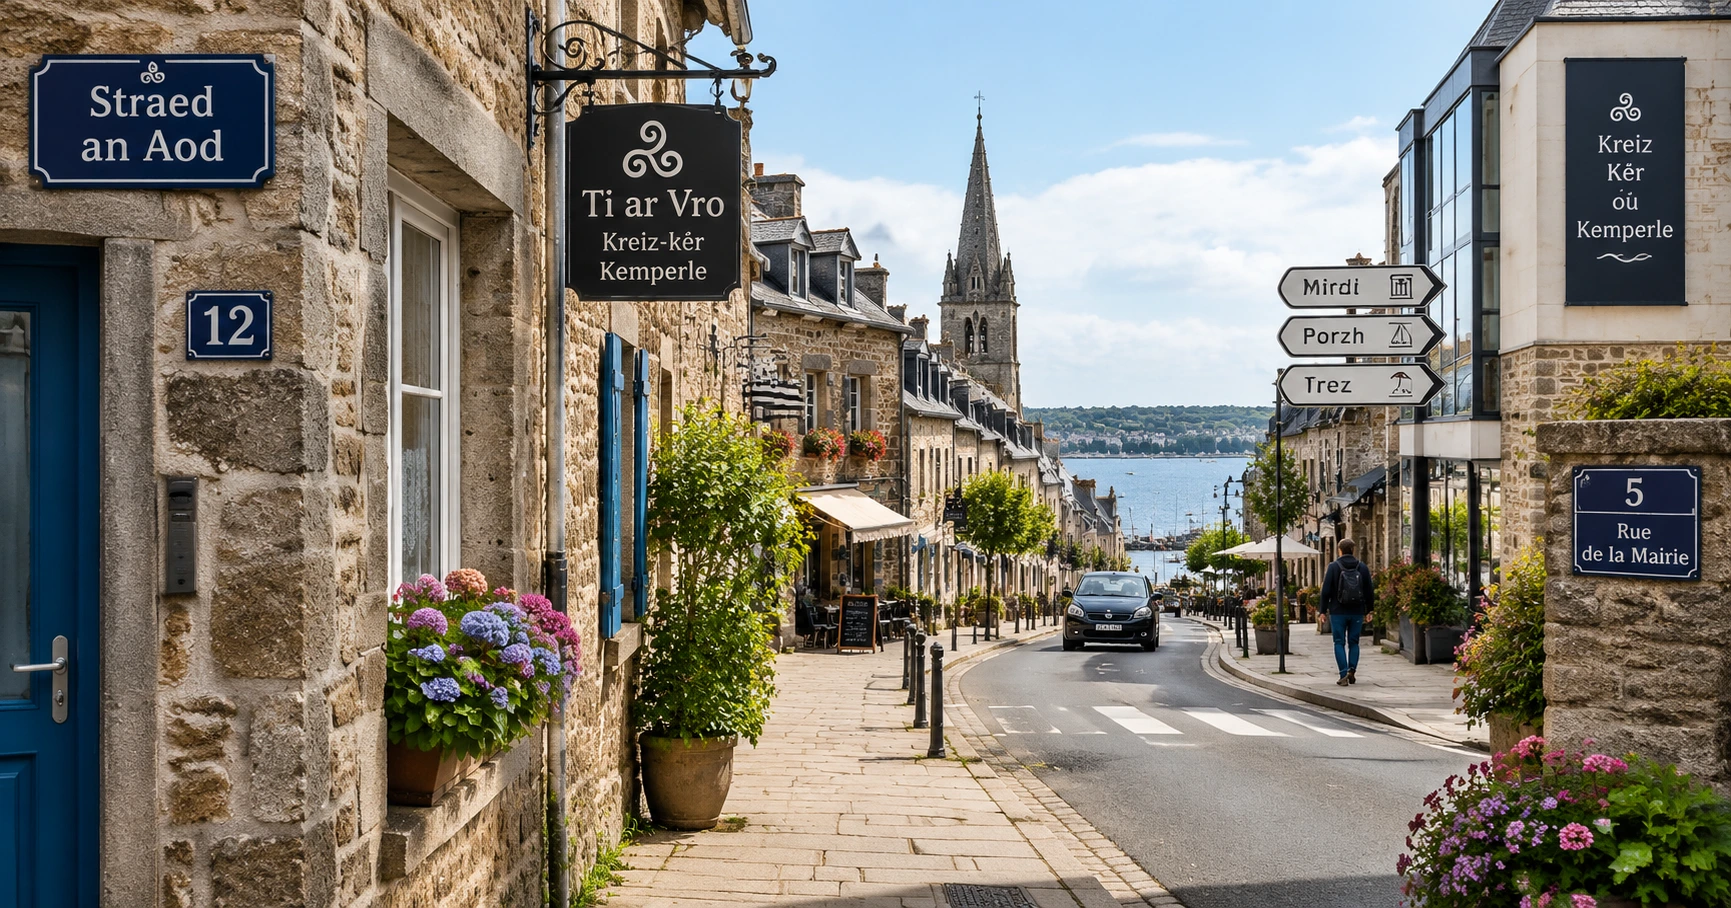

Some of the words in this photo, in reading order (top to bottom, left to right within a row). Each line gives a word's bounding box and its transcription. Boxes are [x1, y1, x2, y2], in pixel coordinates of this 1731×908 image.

[90, 82, 214, 118] Straed
[81, 139, 130, 162] an
[142, 130, 224, 162] Aod
[1598, 135, 1653, 154] Kreiz
[581, 190, 614, 218] Ti
[624, 197, 659, 218] ar
[666, 189, 725, 218] Vro
[1577, 220, 1674, 243] Kemperle
[600, 260, 707, 286] Kemperle
[1303, 279, 1359, 296] Mirdi
[203, 305, 255, 346] 12
[1303, 327, 1364, 345] Porzh
[1304, 377, 1352, 394] Trez
[1625, 478, 1644, 507] 5
[1617, 523, 1652, 540] Rue
[1581, 546, 1604, 562] de
[1608, 546, 1625, 563] la
[1631, 548, 1689, 566] Mairie
